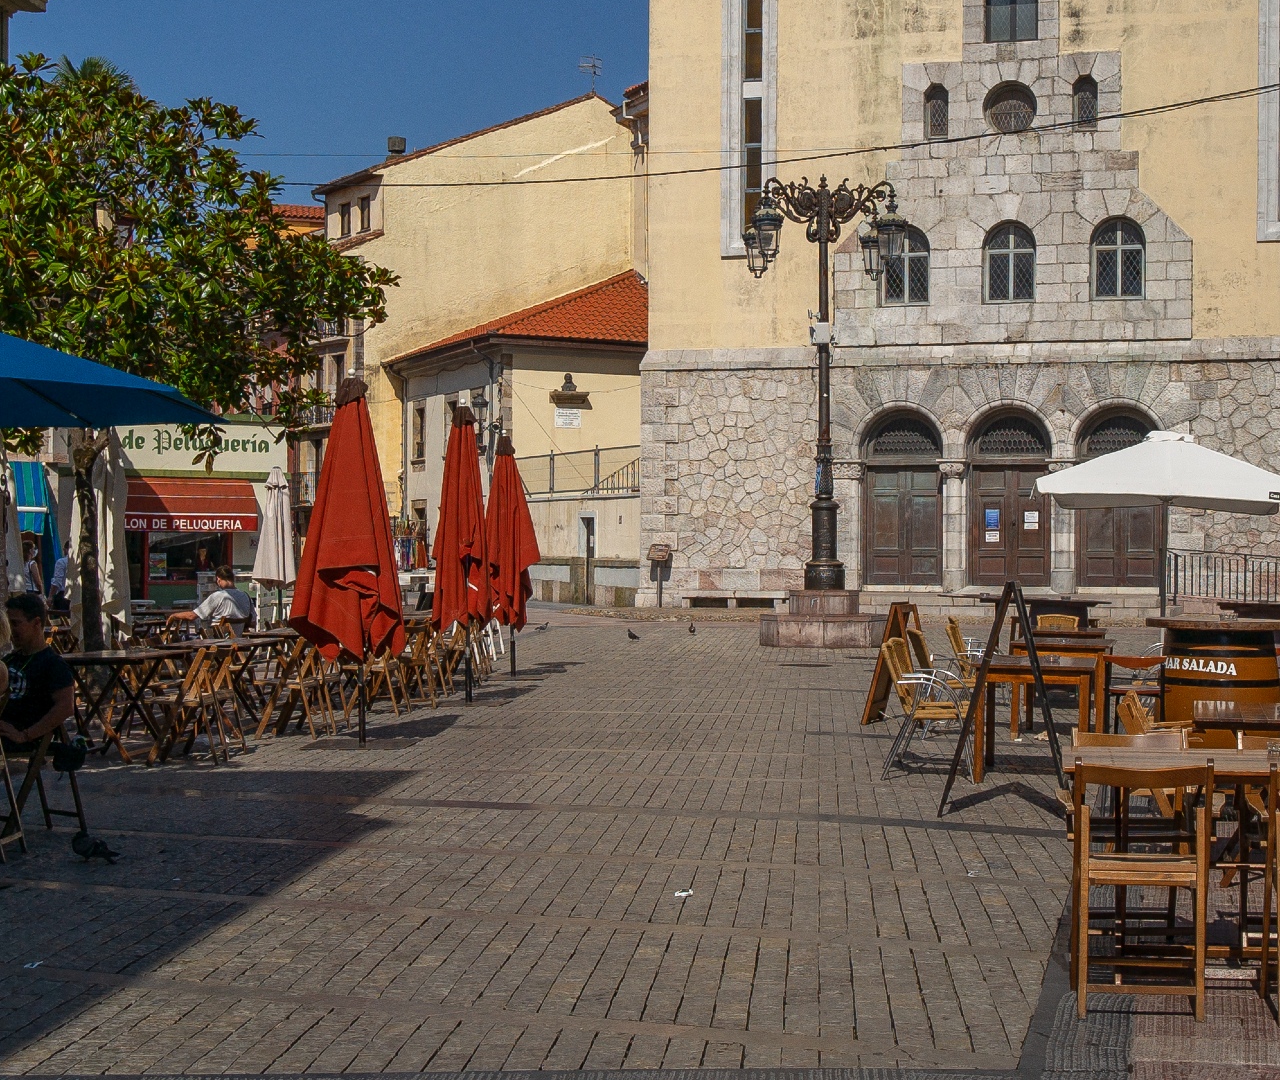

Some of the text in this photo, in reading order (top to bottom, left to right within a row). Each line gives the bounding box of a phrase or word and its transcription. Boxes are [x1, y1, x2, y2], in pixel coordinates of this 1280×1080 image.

[122, 429, 146, 449] de
[152, 519, 167, 529] DE
[172, 519, 242, 531] PELUQUERIA
[1182, 658, 1238, 676] SALADA
